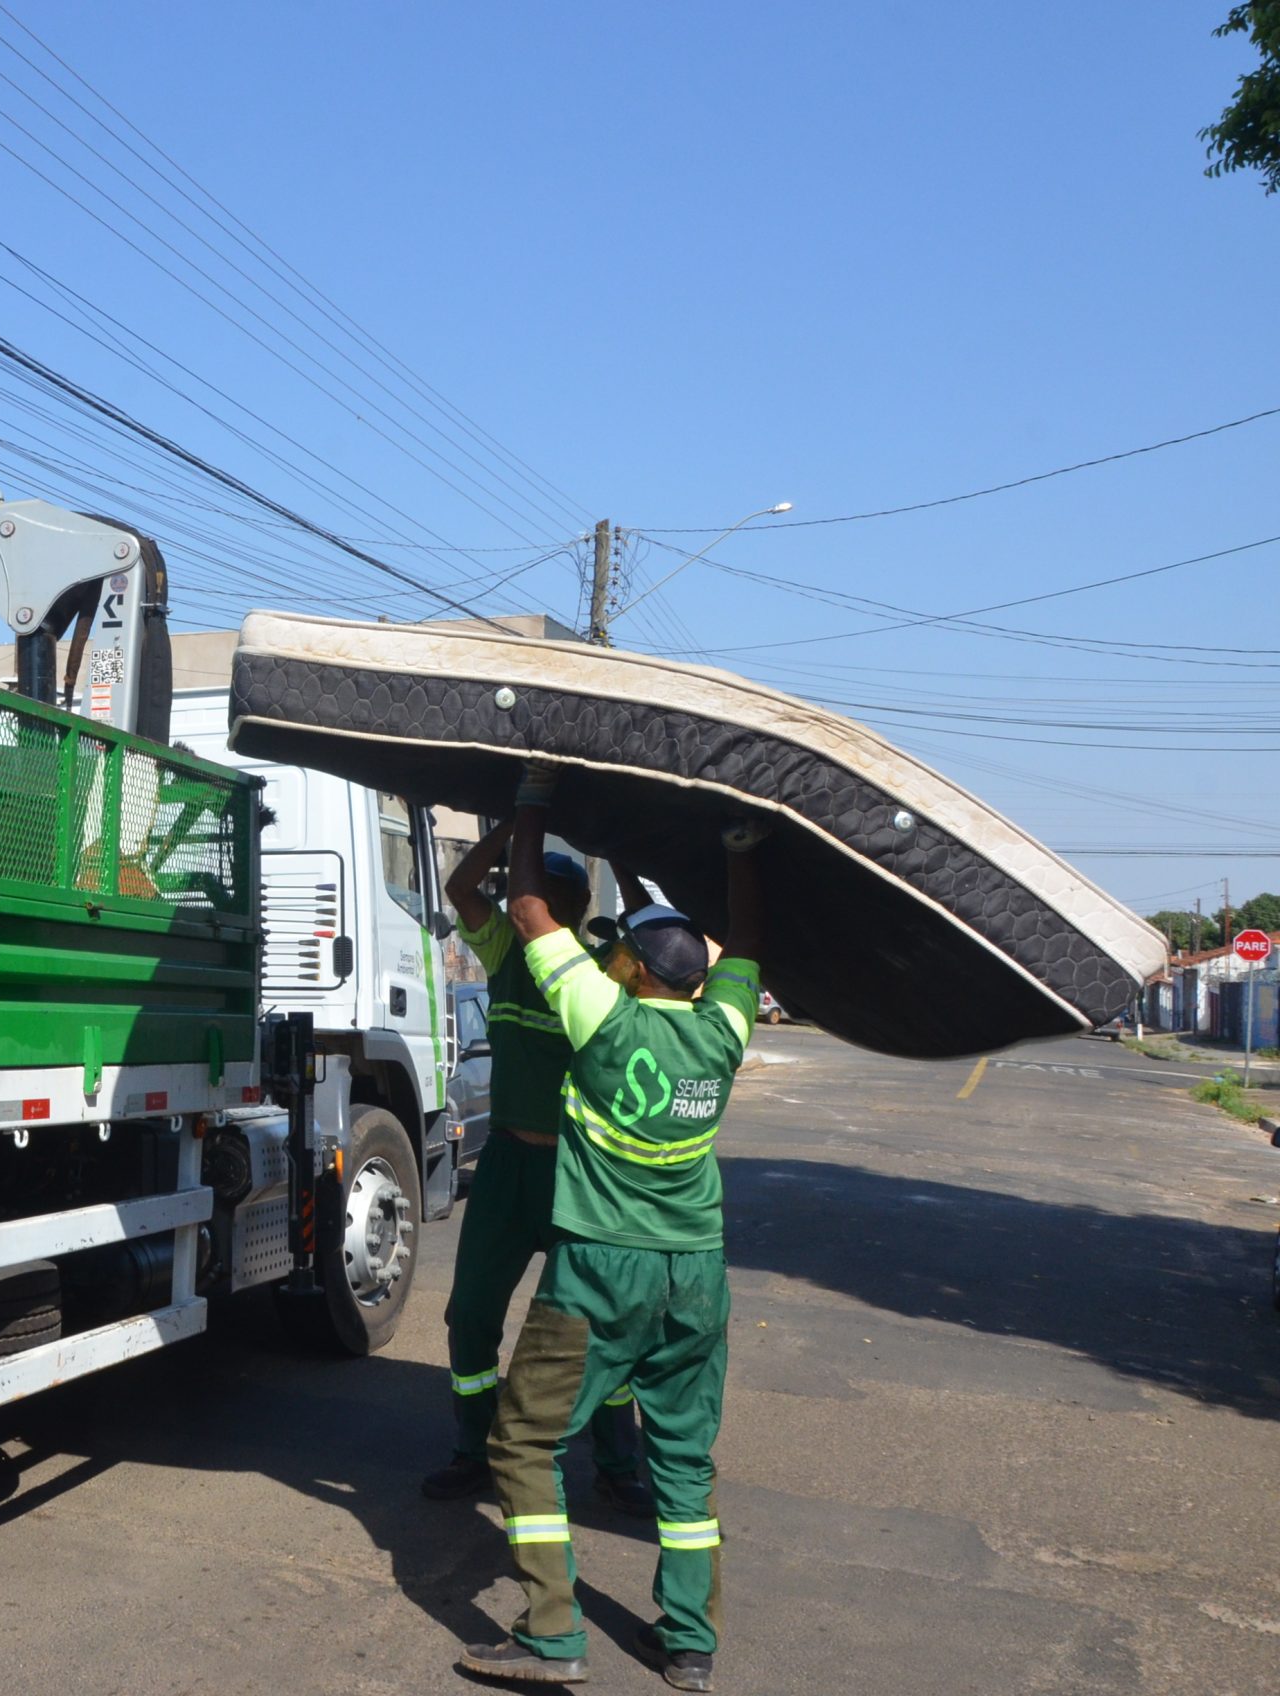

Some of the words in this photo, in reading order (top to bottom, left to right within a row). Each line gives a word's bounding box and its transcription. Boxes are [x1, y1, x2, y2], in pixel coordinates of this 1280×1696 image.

[1236, 941, 1268, 951] PARE
[675, 1078, 722, 1098] SEMPRE
[670, 1098, 717, 1119] FRANCA
